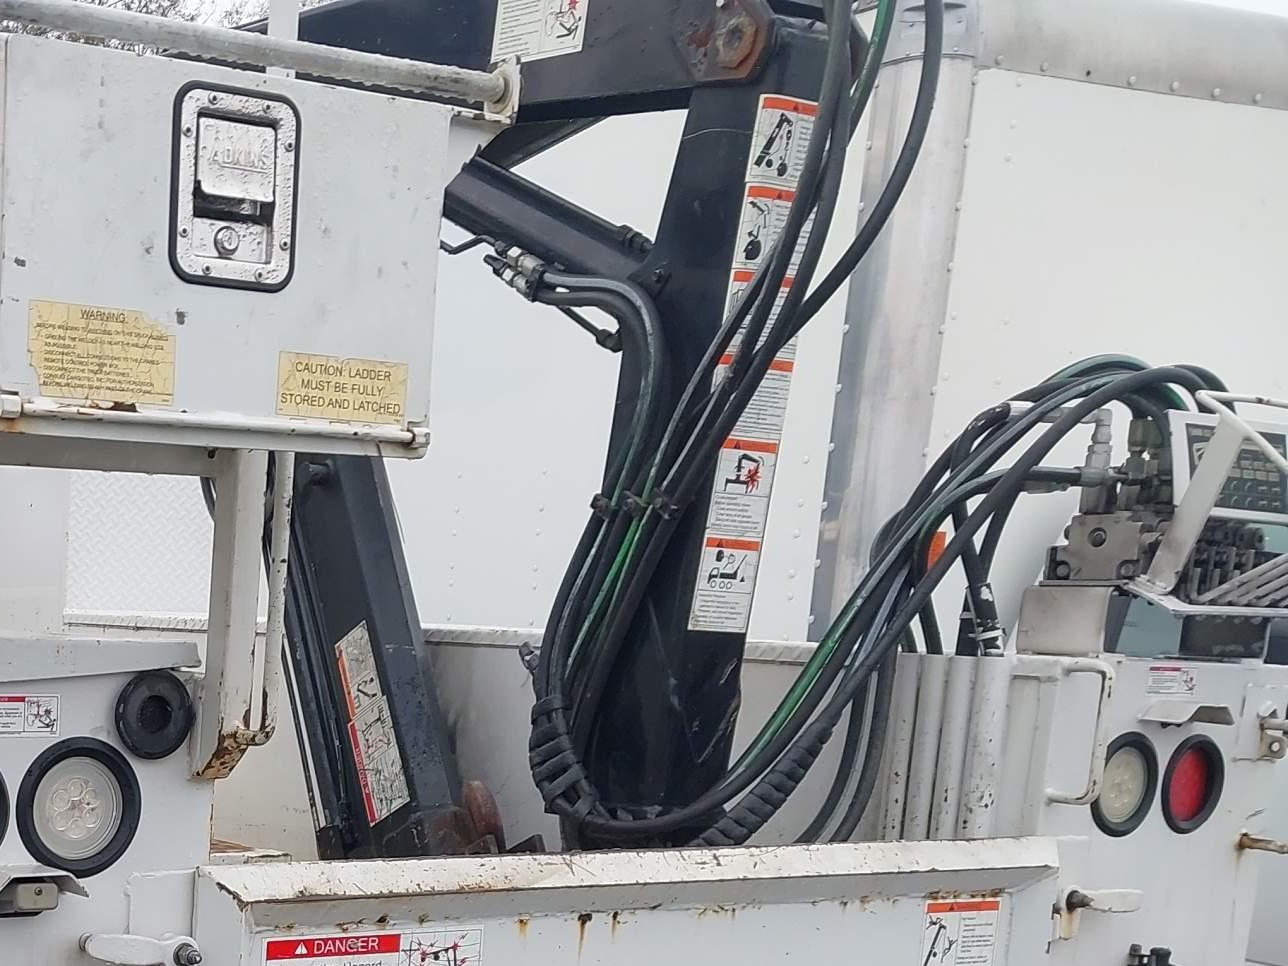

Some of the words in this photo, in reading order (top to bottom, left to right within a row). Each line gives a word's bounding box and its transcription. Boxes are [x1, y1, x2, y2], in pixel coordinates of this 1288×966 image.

[80, 309, 126, 322] WARNING
[349, 368, 392, 381] LADDER
[301, 379, 331, 391] MUST
[334, 382, 348, 393] BE
[351, 384, 384, 396] FULLY
[281, 393, 326, 407] STORED
[327, 398, 350, 409] AND
[353, 400, 401, 414] LATCHED
[314, 937, 379, 954] DANGER
